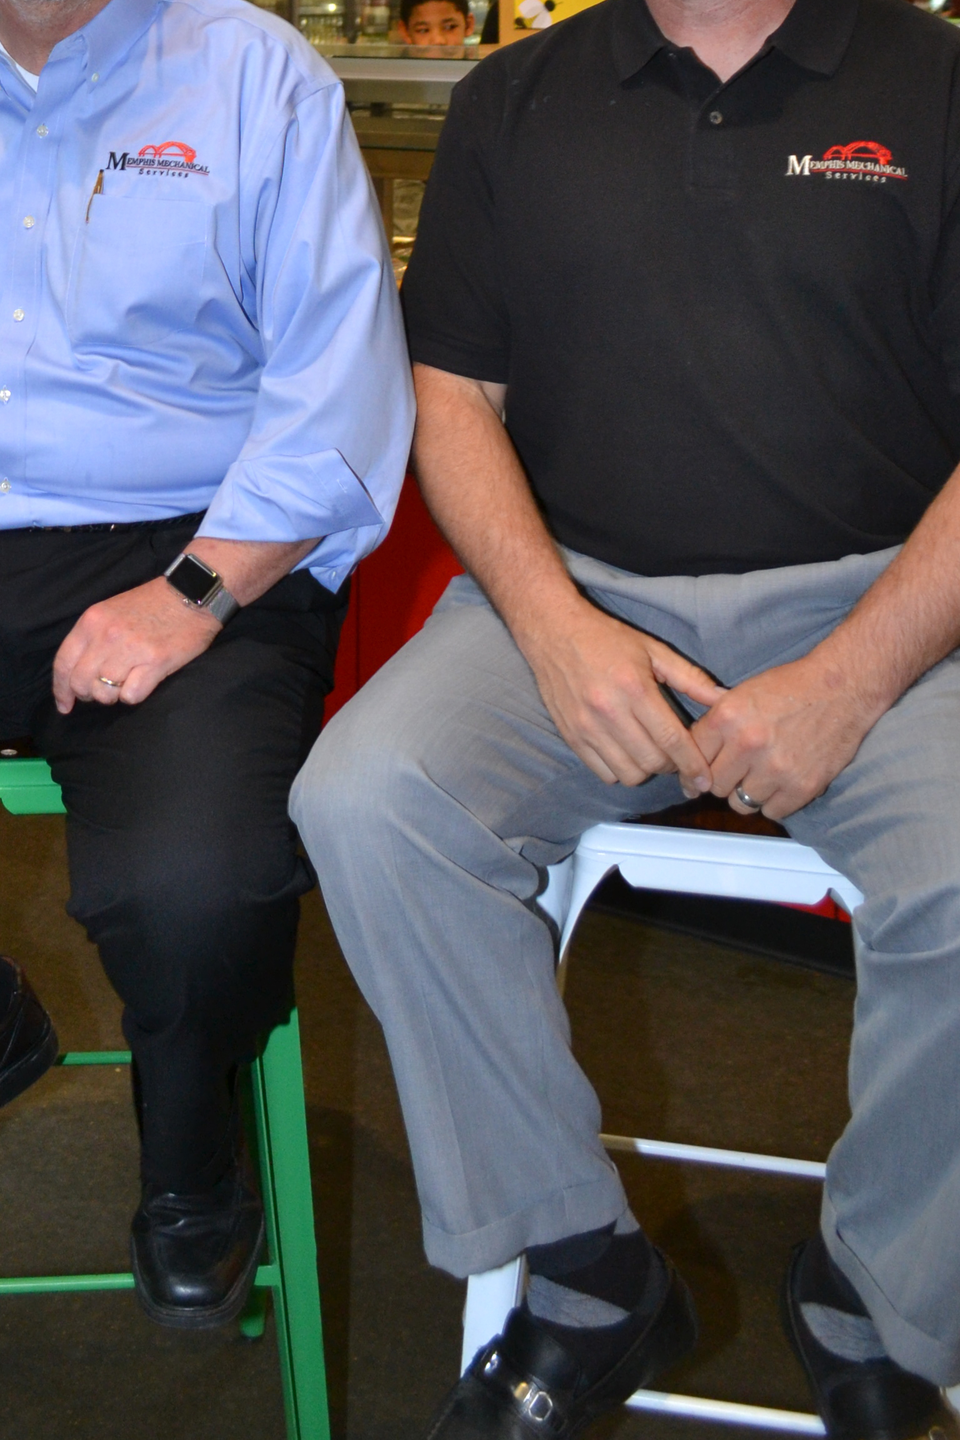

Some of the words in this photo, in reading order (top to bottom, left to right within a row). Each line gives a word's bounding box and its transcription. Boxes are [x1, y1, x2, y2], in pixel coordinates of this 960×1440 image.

[106, 151, 156, 171] MEMPHIS
[157, 158, 210, 174] MECHANICAL
[785, 155, 846, 176] MEMPHIS
[846, 160, 908, 177] MECHANICAL
[139, 168, 189, 178] Services
[825, 171, 887, 183] Services
